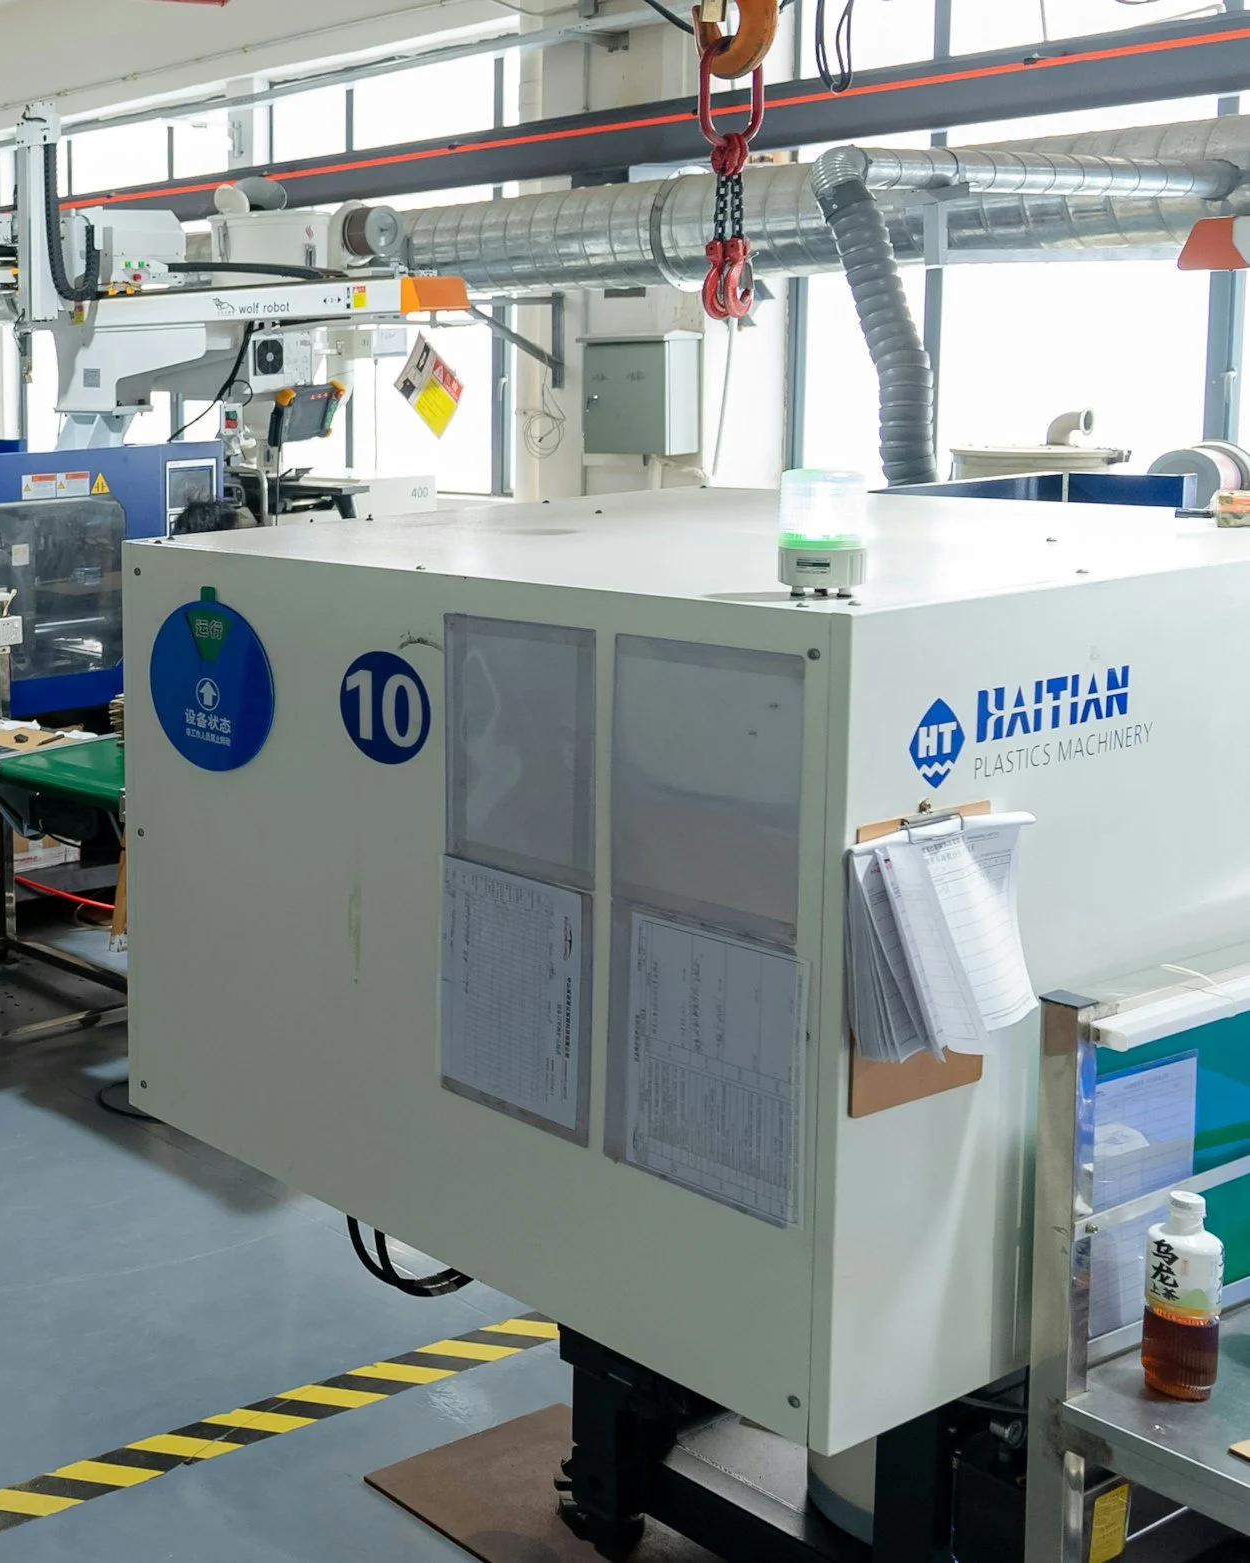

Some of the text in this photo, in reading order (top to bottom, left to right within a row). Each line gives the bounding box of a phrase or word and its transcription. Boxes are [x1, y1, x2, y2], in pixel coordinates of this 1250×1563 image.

[238, 301, 290, 314] wolf robot
[411, 486, 429, 498] 400
[195, 618, 224, 641] 运行
[346, 669, 423, 748] 10
[976, 665, 1130, 743] HAITIAN
[184, 708, 232, 734] 设备状态
[917, 721, 958, 759] HT
[974, 721, 1154, 780] PLASTICS MACHINERY
